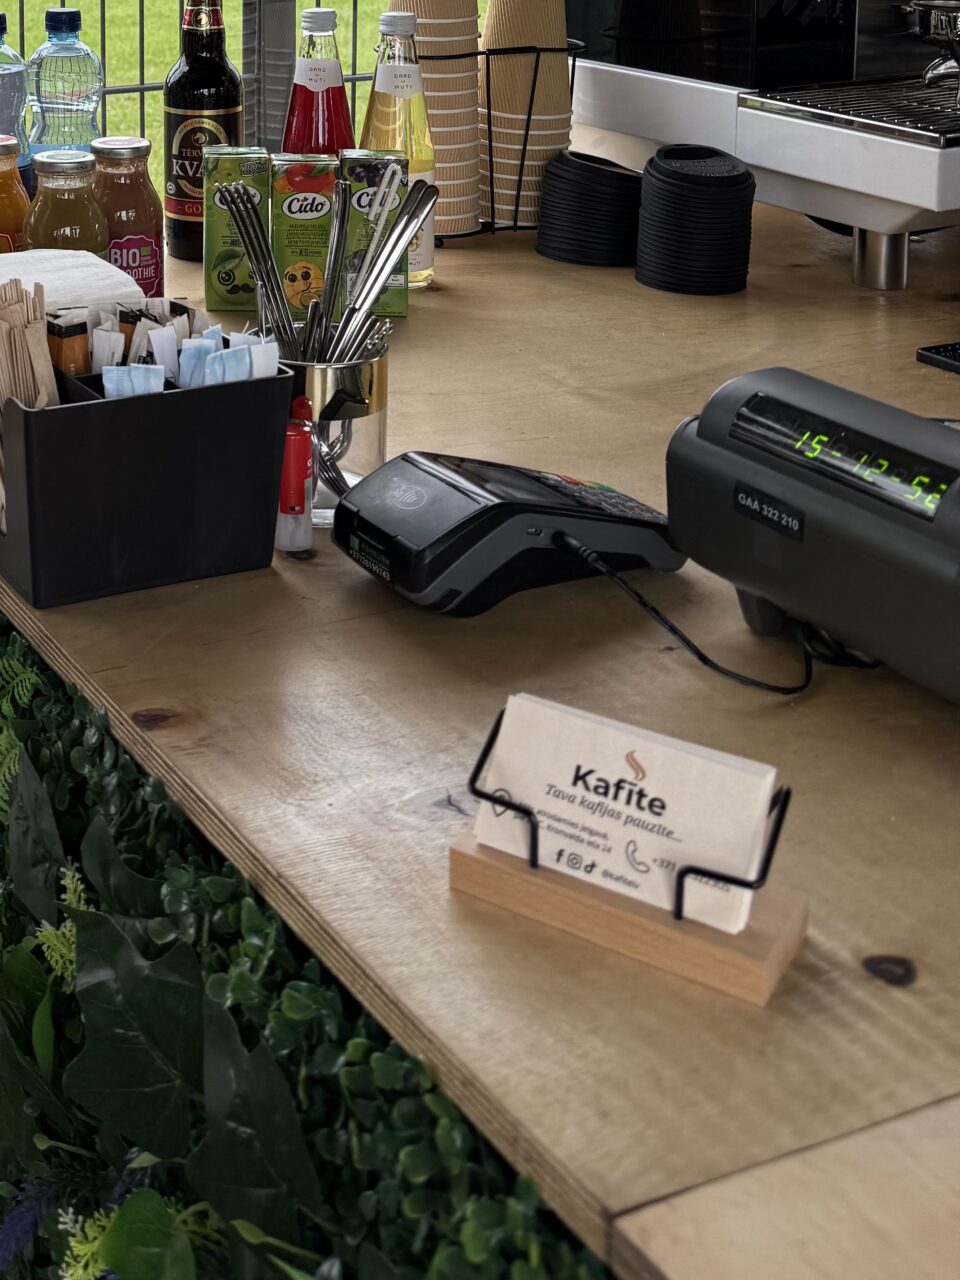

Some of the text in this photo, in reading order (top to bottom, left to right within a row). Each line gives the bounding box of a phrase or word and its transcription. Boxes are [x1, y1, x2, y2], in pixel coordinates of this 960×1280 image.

[184, 204, 203, 214] GO
[287, 196, 326, 215] Cido
[110, 248, 141, 267] BIO
[761, 504, 780, 522] 322
[780, 513, 800, 531] 210
[571, 764, 667, 817] Kafīte
[546, 783, 577, 804] Tava
[579, 795, 622, 822] kafijas
